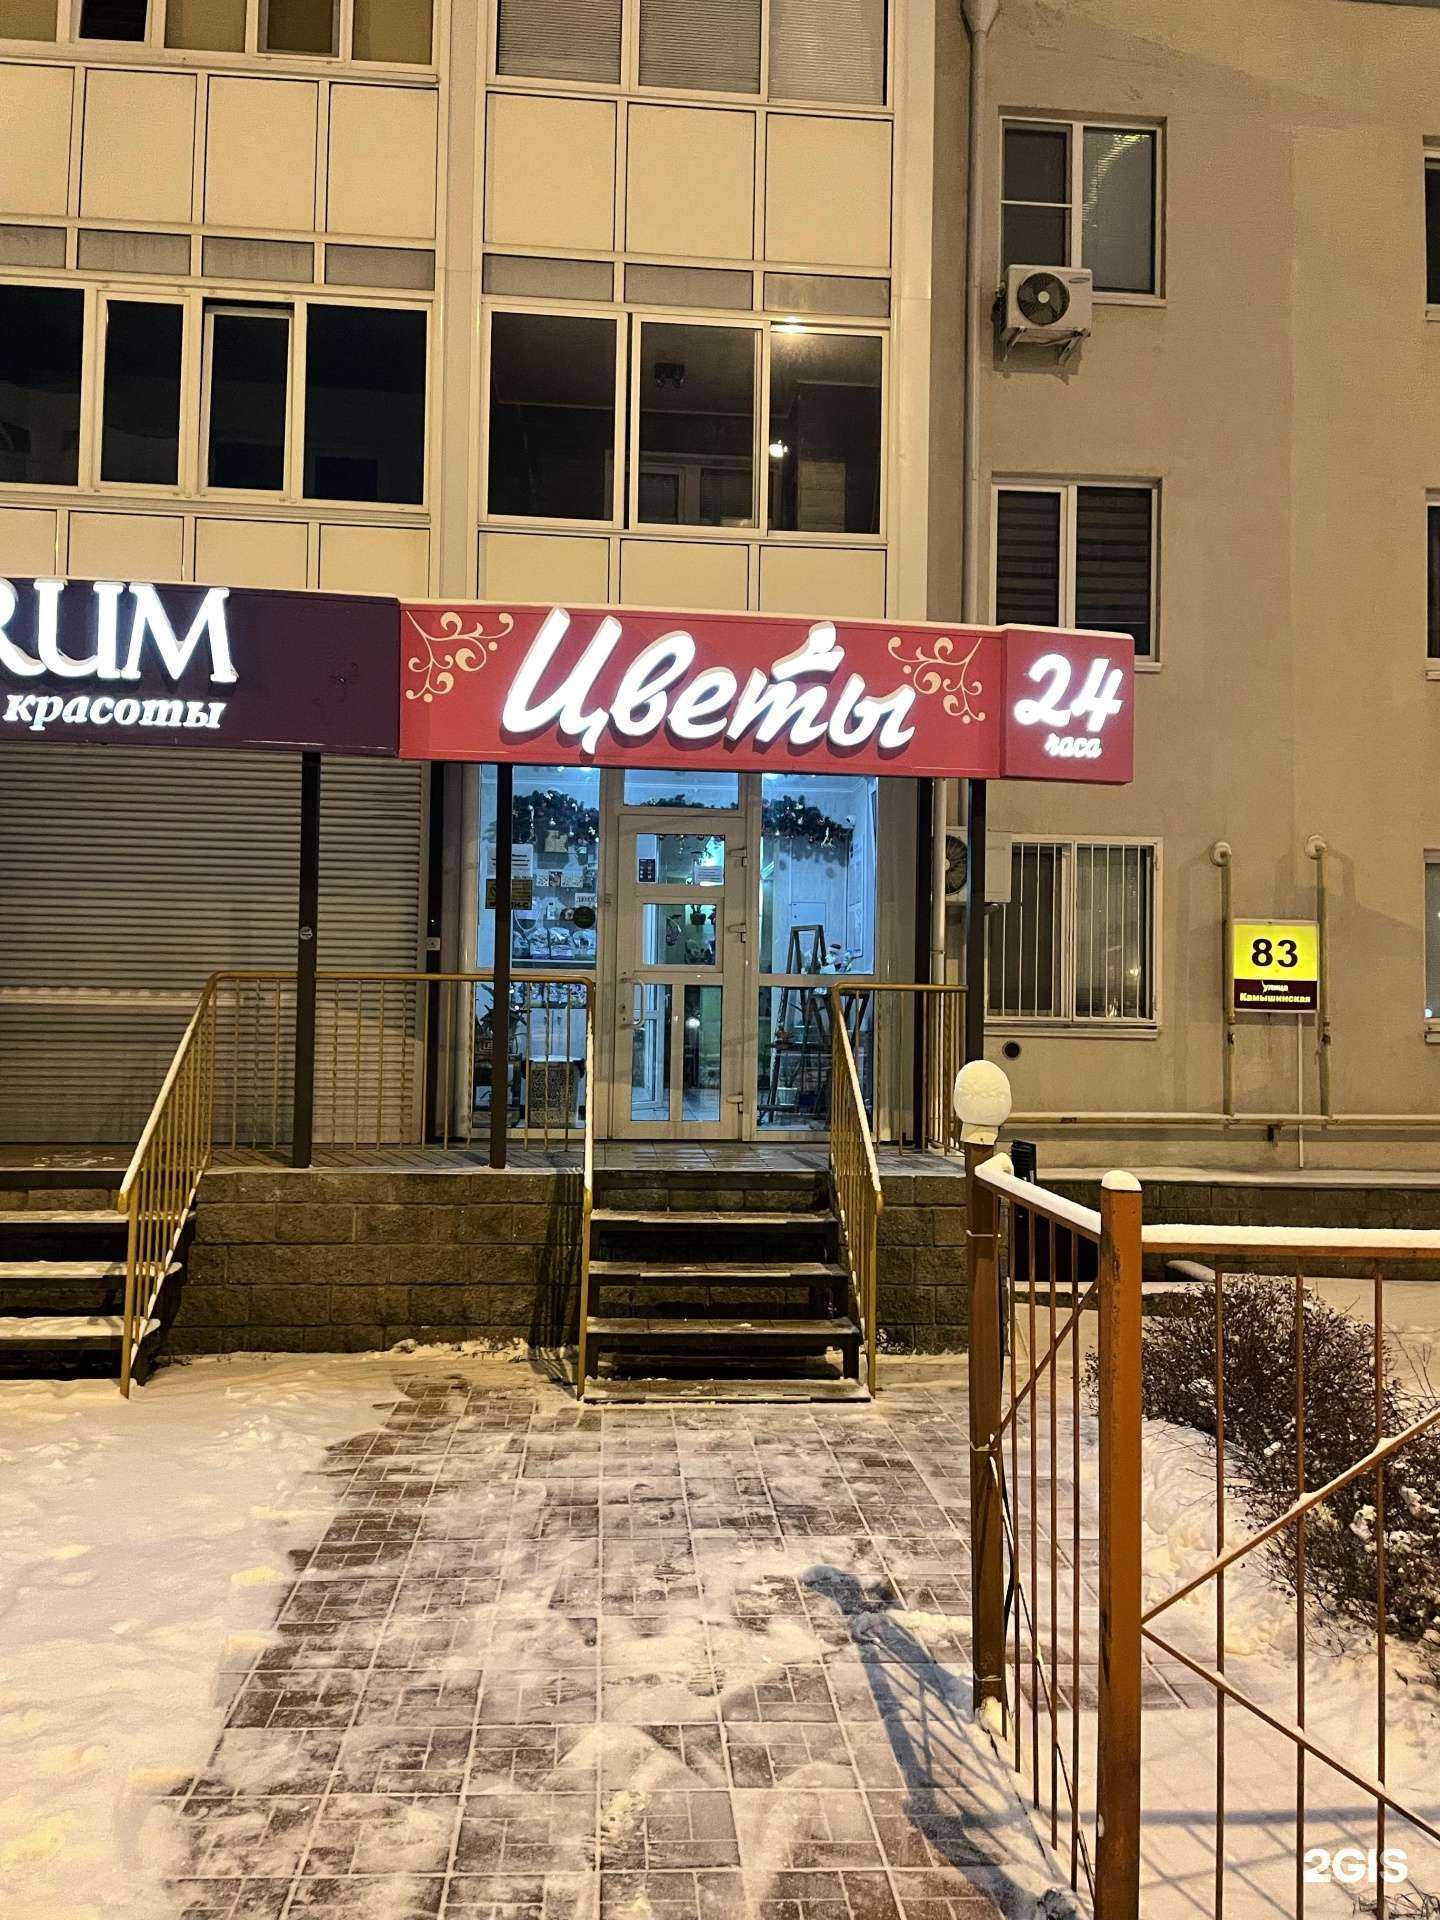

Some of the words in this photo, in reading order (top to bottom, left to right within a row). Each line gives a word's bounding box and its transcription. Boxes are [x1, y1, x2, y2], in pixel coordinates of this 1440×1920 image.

[501, 607, 917, 754] Цветы
[1013, 652, 1125, 733] 24
[3, 694, 228, 731] красоты
[1044, 733, 1103, 759] часа
[1251, 938, 1298, 968] 83
[1240, 993, 1311, 1003] Камышинская
